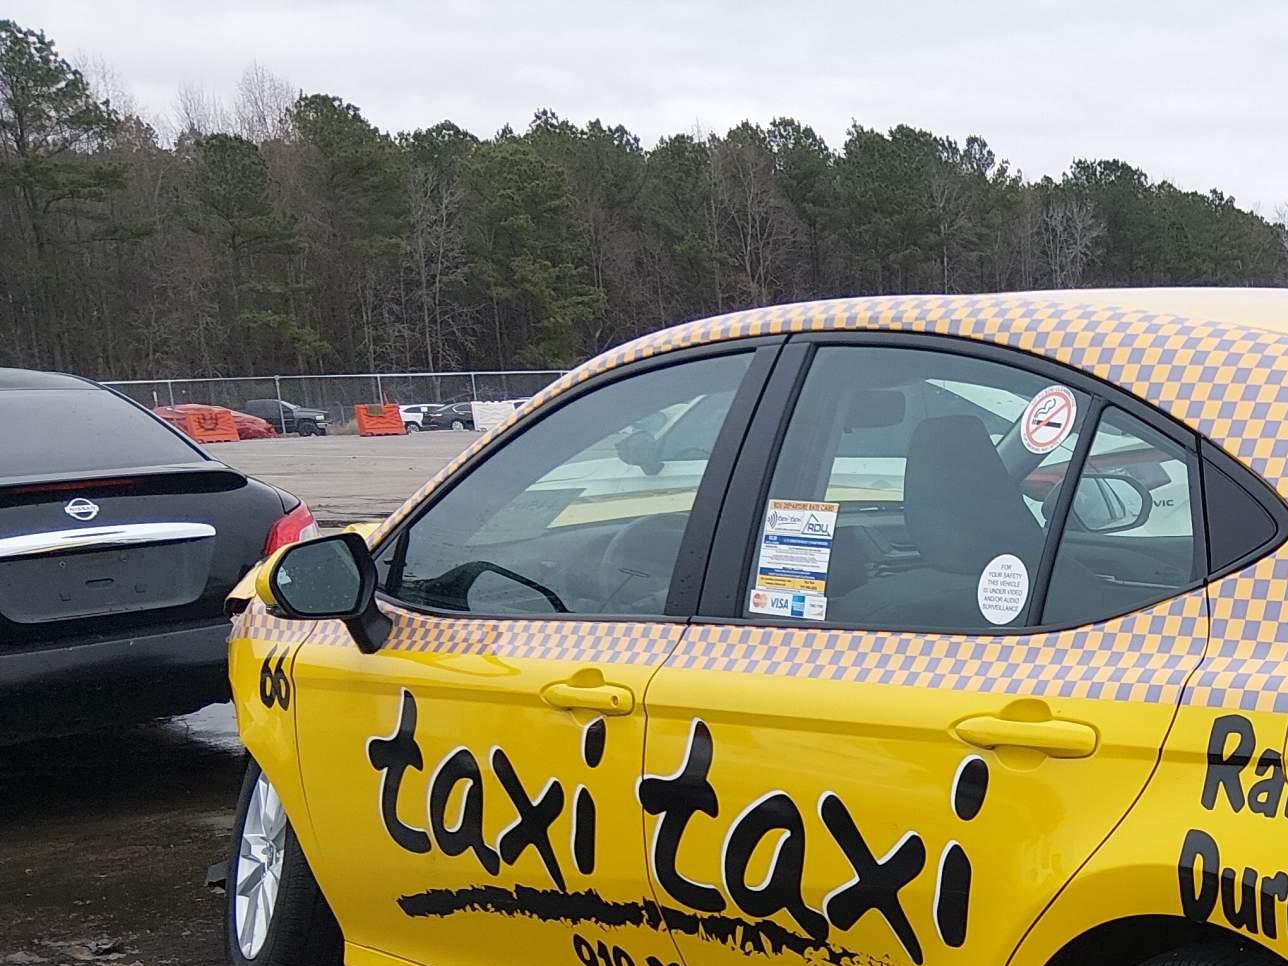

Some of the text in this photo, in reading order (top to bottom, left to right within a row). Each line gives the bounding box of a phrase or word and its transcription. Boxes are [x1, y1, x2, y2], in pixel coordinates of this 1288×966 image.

[770, 597, 790, 609] VISA
[259, 645, 291, 711] 66
[365, 687, 989, 965] taxi taxi
